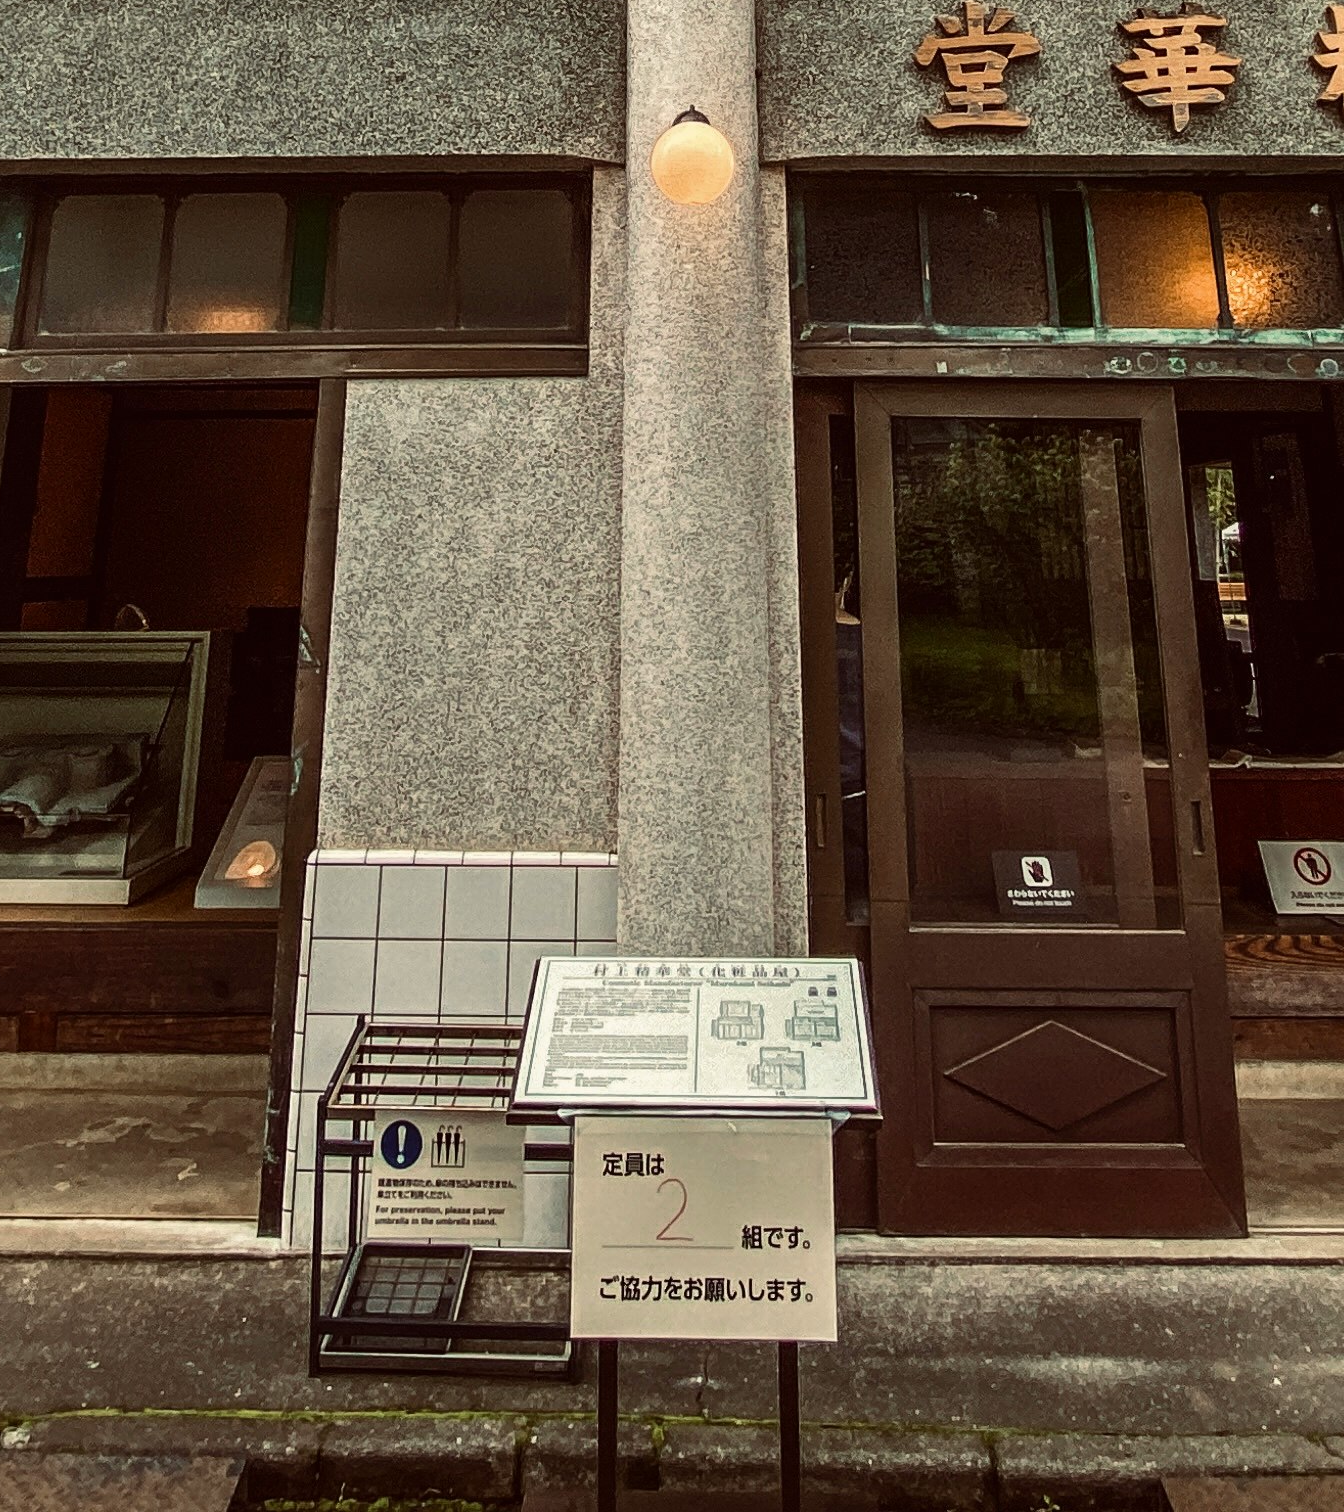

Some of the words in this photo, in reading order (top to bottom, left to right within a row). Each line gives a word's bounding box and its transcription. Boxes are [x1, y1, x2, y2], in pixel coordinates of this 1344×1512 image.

[602, 1152, 665, 1177] 定員は
[445, 1206, 471, 1215] please
[656, 1178, 694, 1241] 2
[741, 1225, 811, 1250] 組です。
[599, 1275, 814, 1303] ご協力をお願いします。
